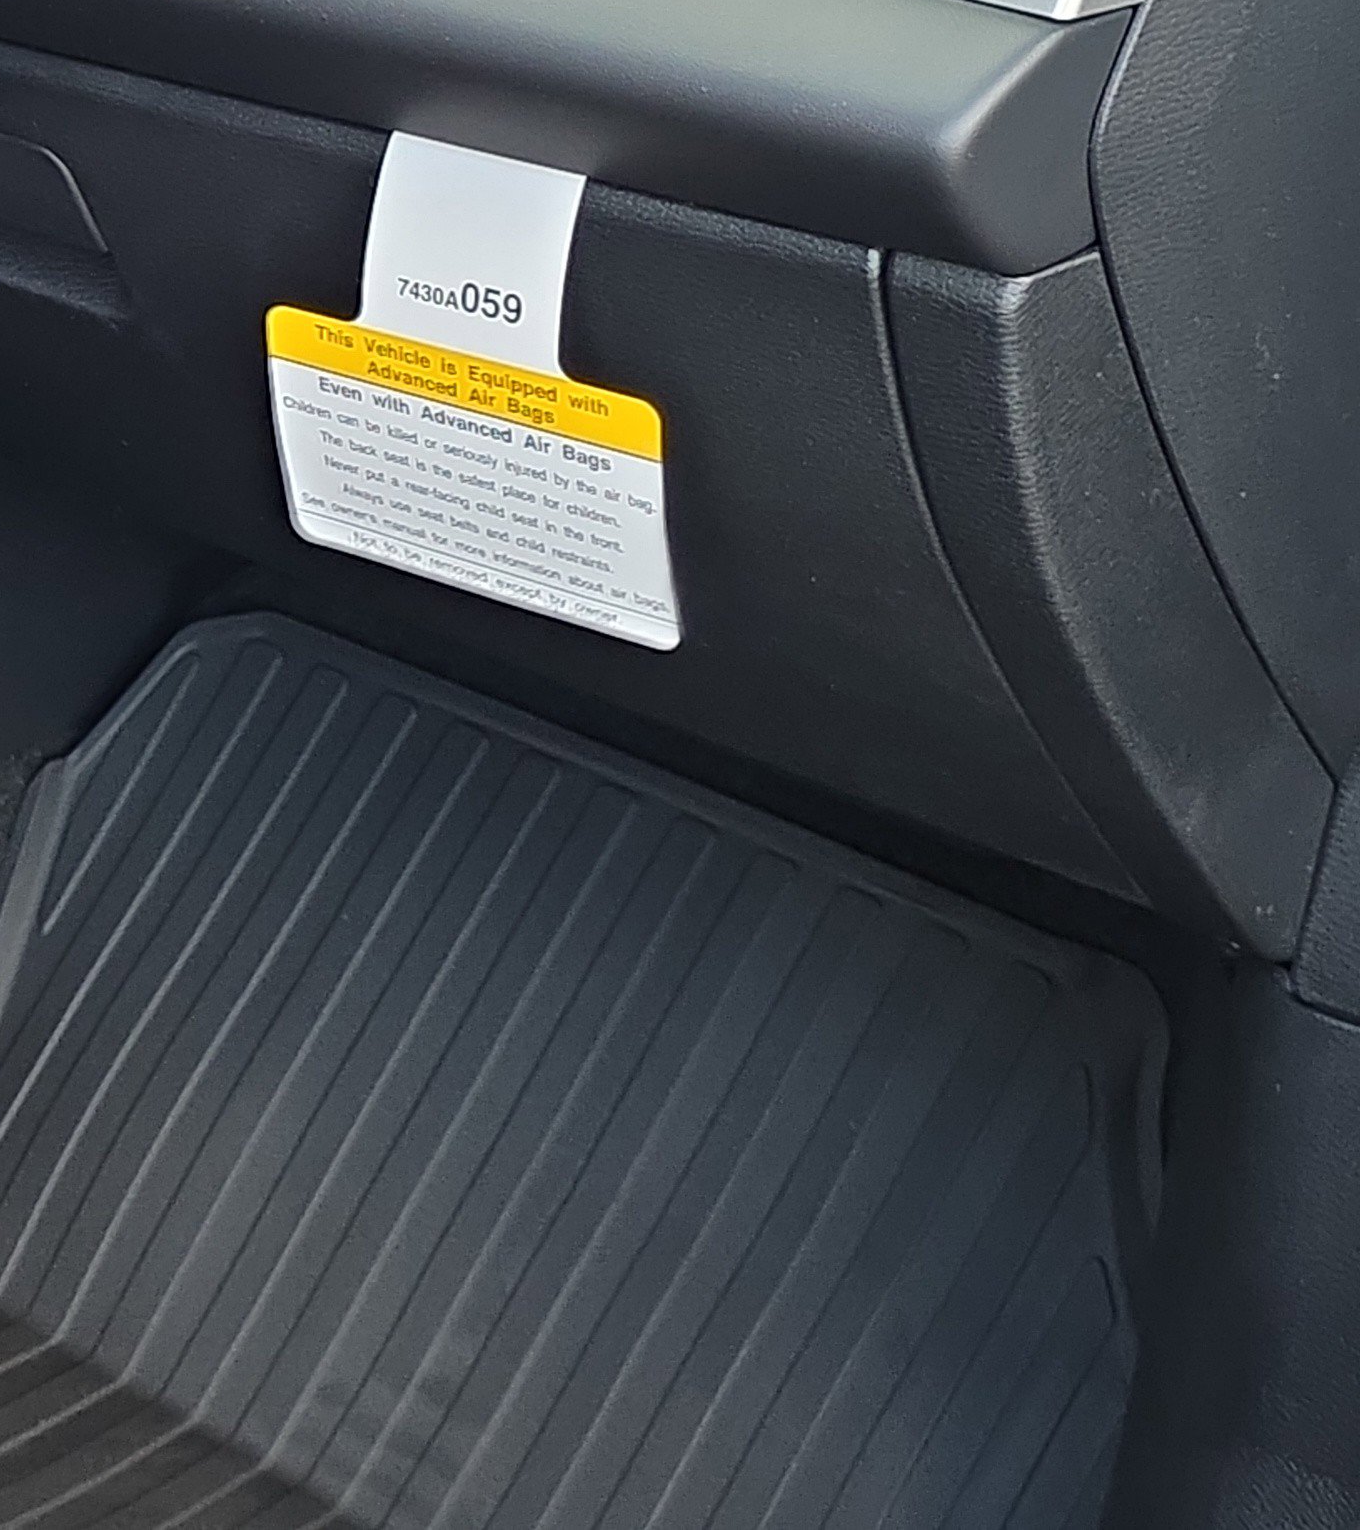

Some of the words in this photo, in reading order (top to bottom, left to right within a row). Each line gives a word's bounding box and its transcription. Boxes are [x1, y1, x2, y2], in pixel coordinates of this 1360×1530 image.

[398, 277, 522, 324] 7430A059
[314, 324, 354, 349] This
[364, 336, 431, 369] Vehicle
[440, 356, 458, 376] is
[468, 365, 558, 404] Equipped
[567, 394, 610, 417] with
[367, 360, 458, 398] Advanced
[468, 388, 497, 408] Air
[506, 396, 556, 425] Bags
[283, 395, 332, 420] Children
[336, 413, 360, 428] can
[364, 418, 381, 434] be
[424, 438, 438, 449] or
[443, 444, 499, 471] seriously
[504, 457, 547, 482] injured
[553, 472, 570, 490] by
[576, 479, 598, 497] the
[318, 375, 363, 402] Even
[372, 393, 412, 416] with
[421, 405, 513, 444] Advanced
[523, 434, 552, 455] Air
[562, 444, 613, 472] Bags
[319, 429, 344, 448] The
[348, 438, 379, 458] back
[383, 450, 411, 468] seat
[415, 458, 427, 472] is
[431, 463, 453, 479] the
[502, 485, 537, 504] place
[543, 494, 560, 511] for
[323, 453, 360, 475] Never
[365, 469, 386, 483] put
[475, 501, 506, 519] child
[511, 512, 539, 529] seat
[545, 519, 558, 534] in
[563, 525, 585, 543] the
[417, 507, 445, 524] seat
[515, 536, 547, 555] child
